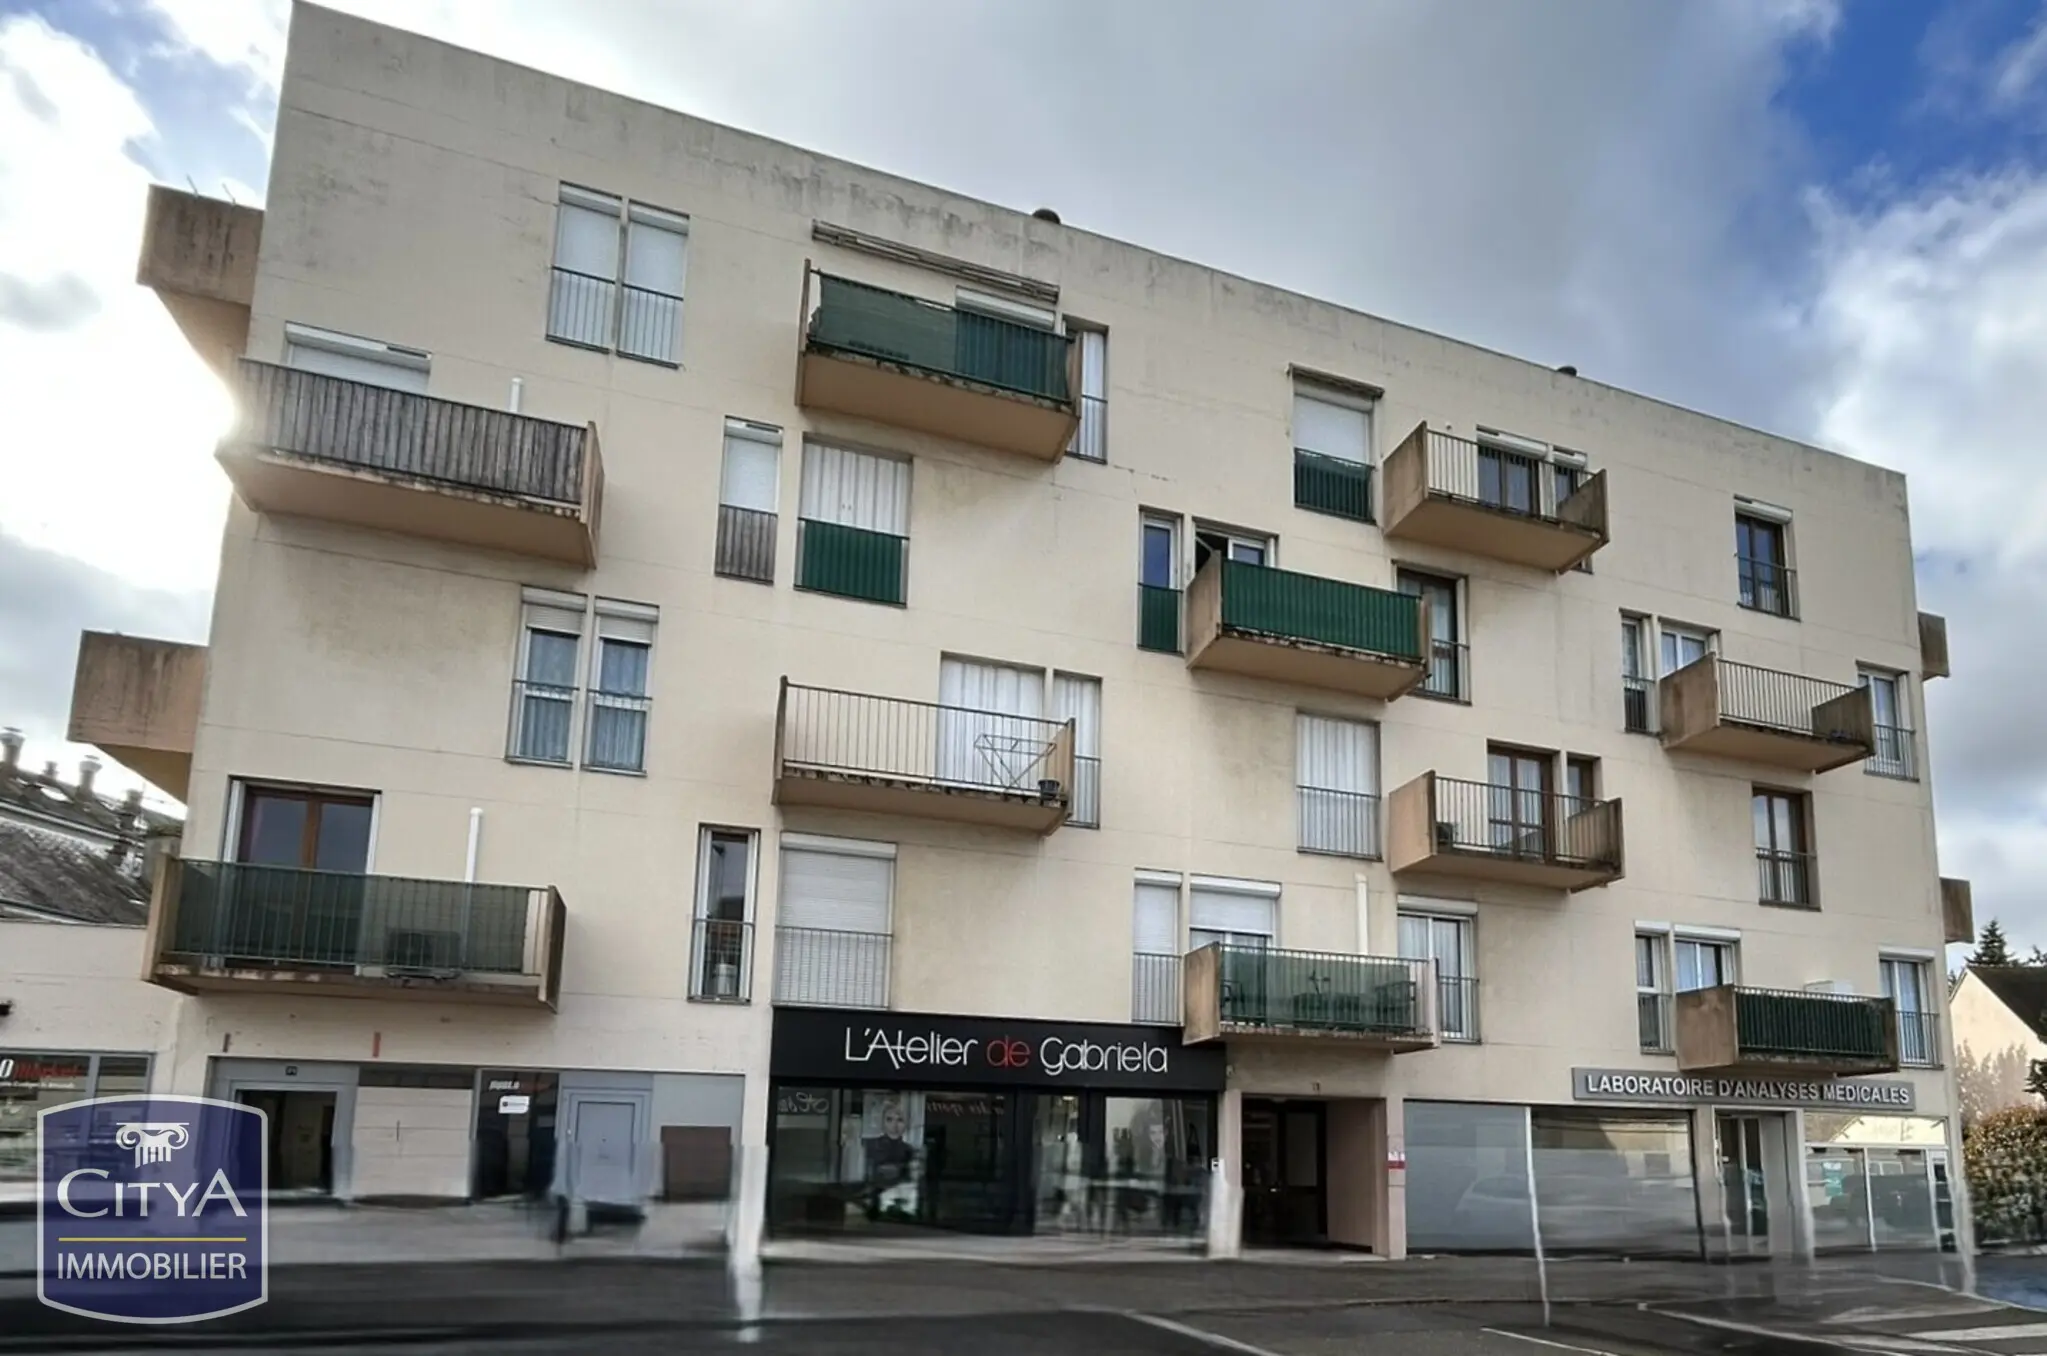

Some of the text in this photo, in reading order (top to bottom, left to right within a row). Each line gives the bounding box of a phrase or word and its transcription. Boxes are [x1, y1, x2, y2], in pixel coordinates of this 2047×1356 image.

[845, 1027, 1169, 1076] L'Atelier de Gabriela
[1587, 1074, 1911, 1104] LABORATOIRE D'ANALYSES MEDICALES
